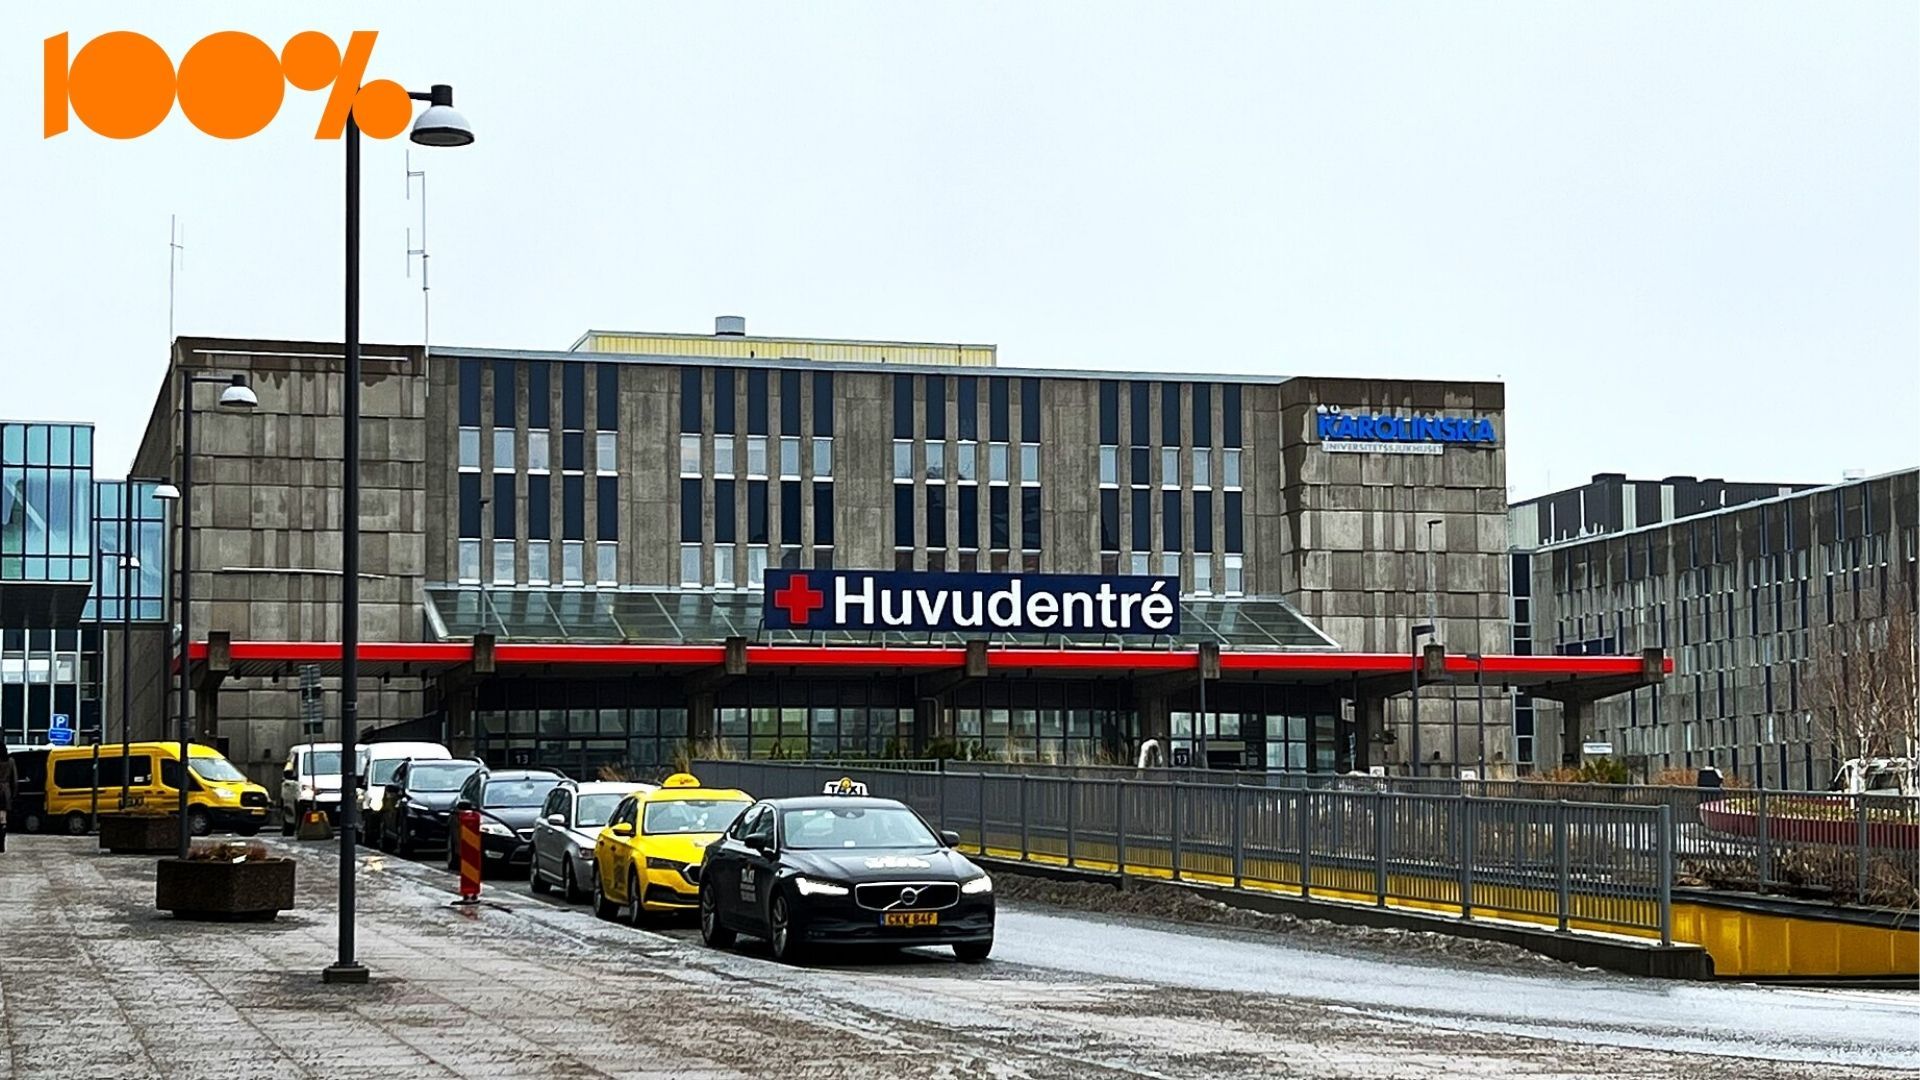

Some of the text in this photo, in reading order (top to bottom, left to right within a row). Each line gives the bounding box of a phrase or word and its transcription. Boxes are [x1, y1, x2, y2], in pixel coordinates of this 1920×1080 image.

[1317, 414, 1496, 442] KAROLINSKA
[835, 575, 1174, 630] Huvudentré
[56, 716, 65, 728] P
[515, 754, 529, 764] 13
[828, 784, 863, 795] TAXI
